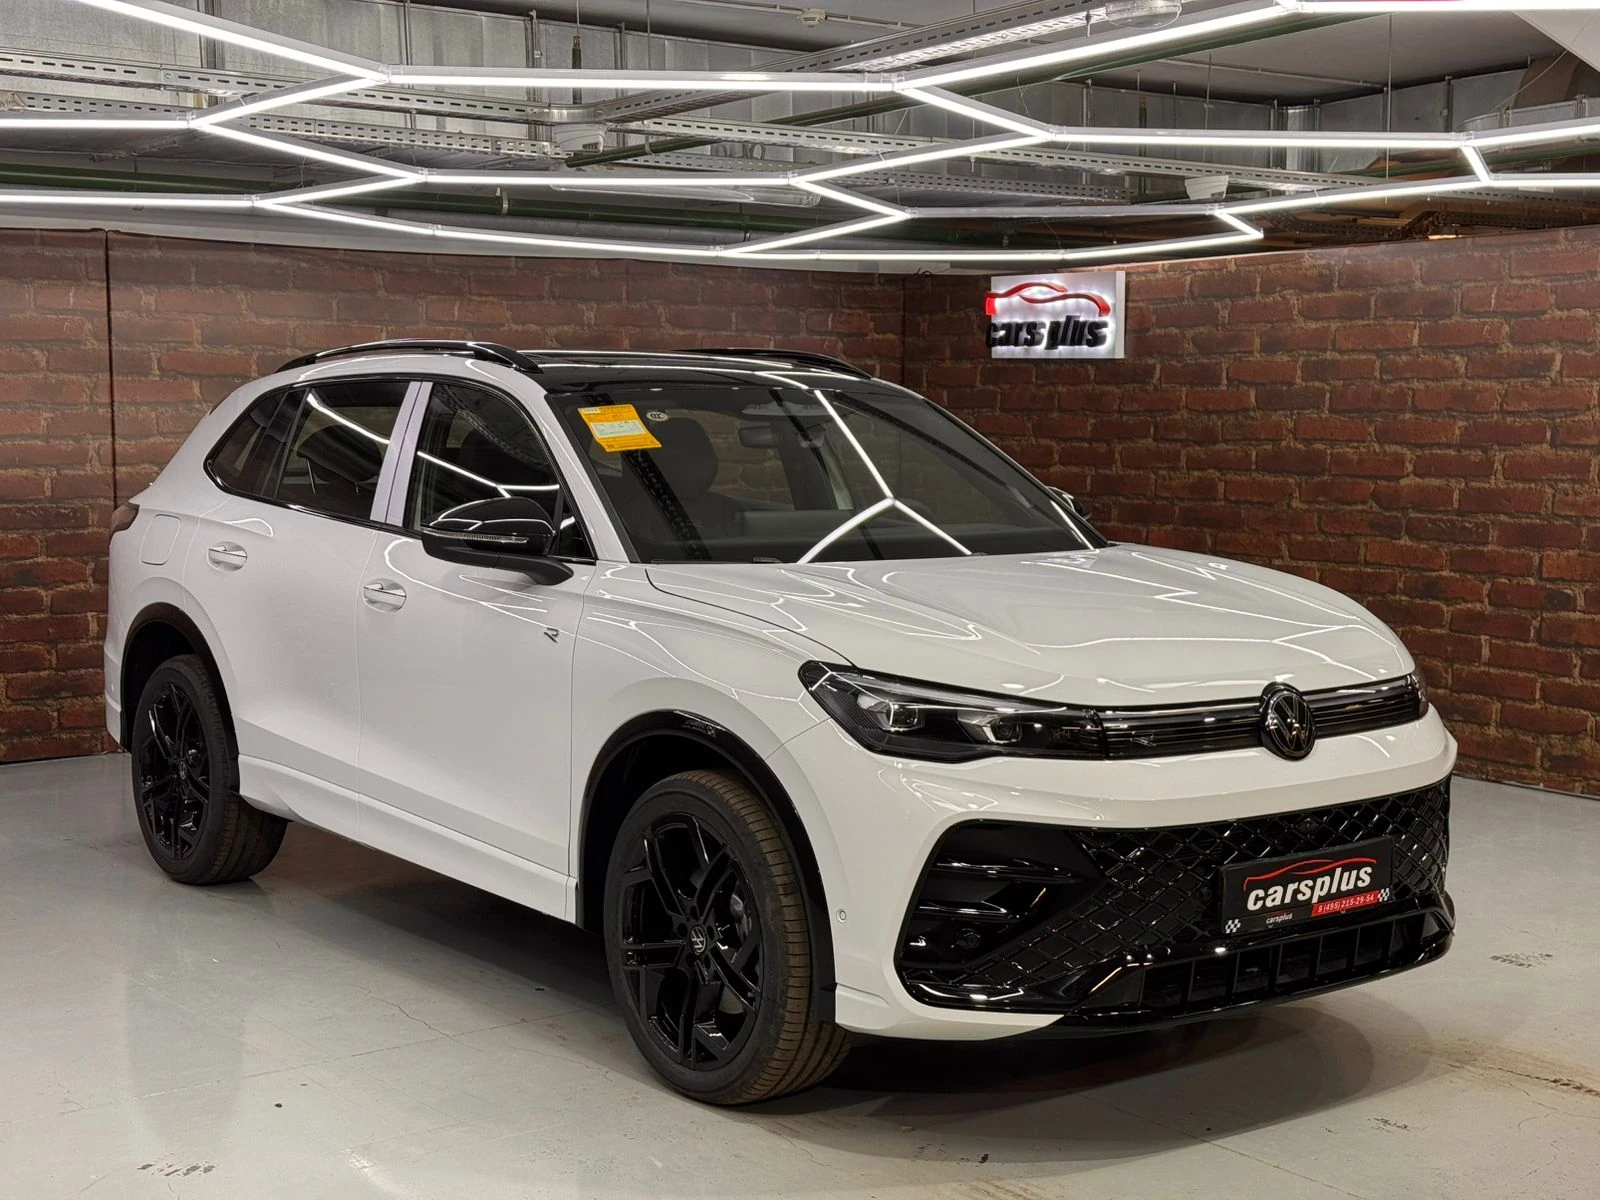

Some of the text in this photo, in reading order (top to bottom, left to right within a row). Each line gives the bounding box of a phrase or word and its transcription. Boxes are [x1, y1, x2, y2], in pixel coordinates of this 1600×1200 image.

[1246, 866, 1373, 911] carsplus
[1323, 901, 1341, 912] (495)
[1265, 912, 1293, 924] carsplus
